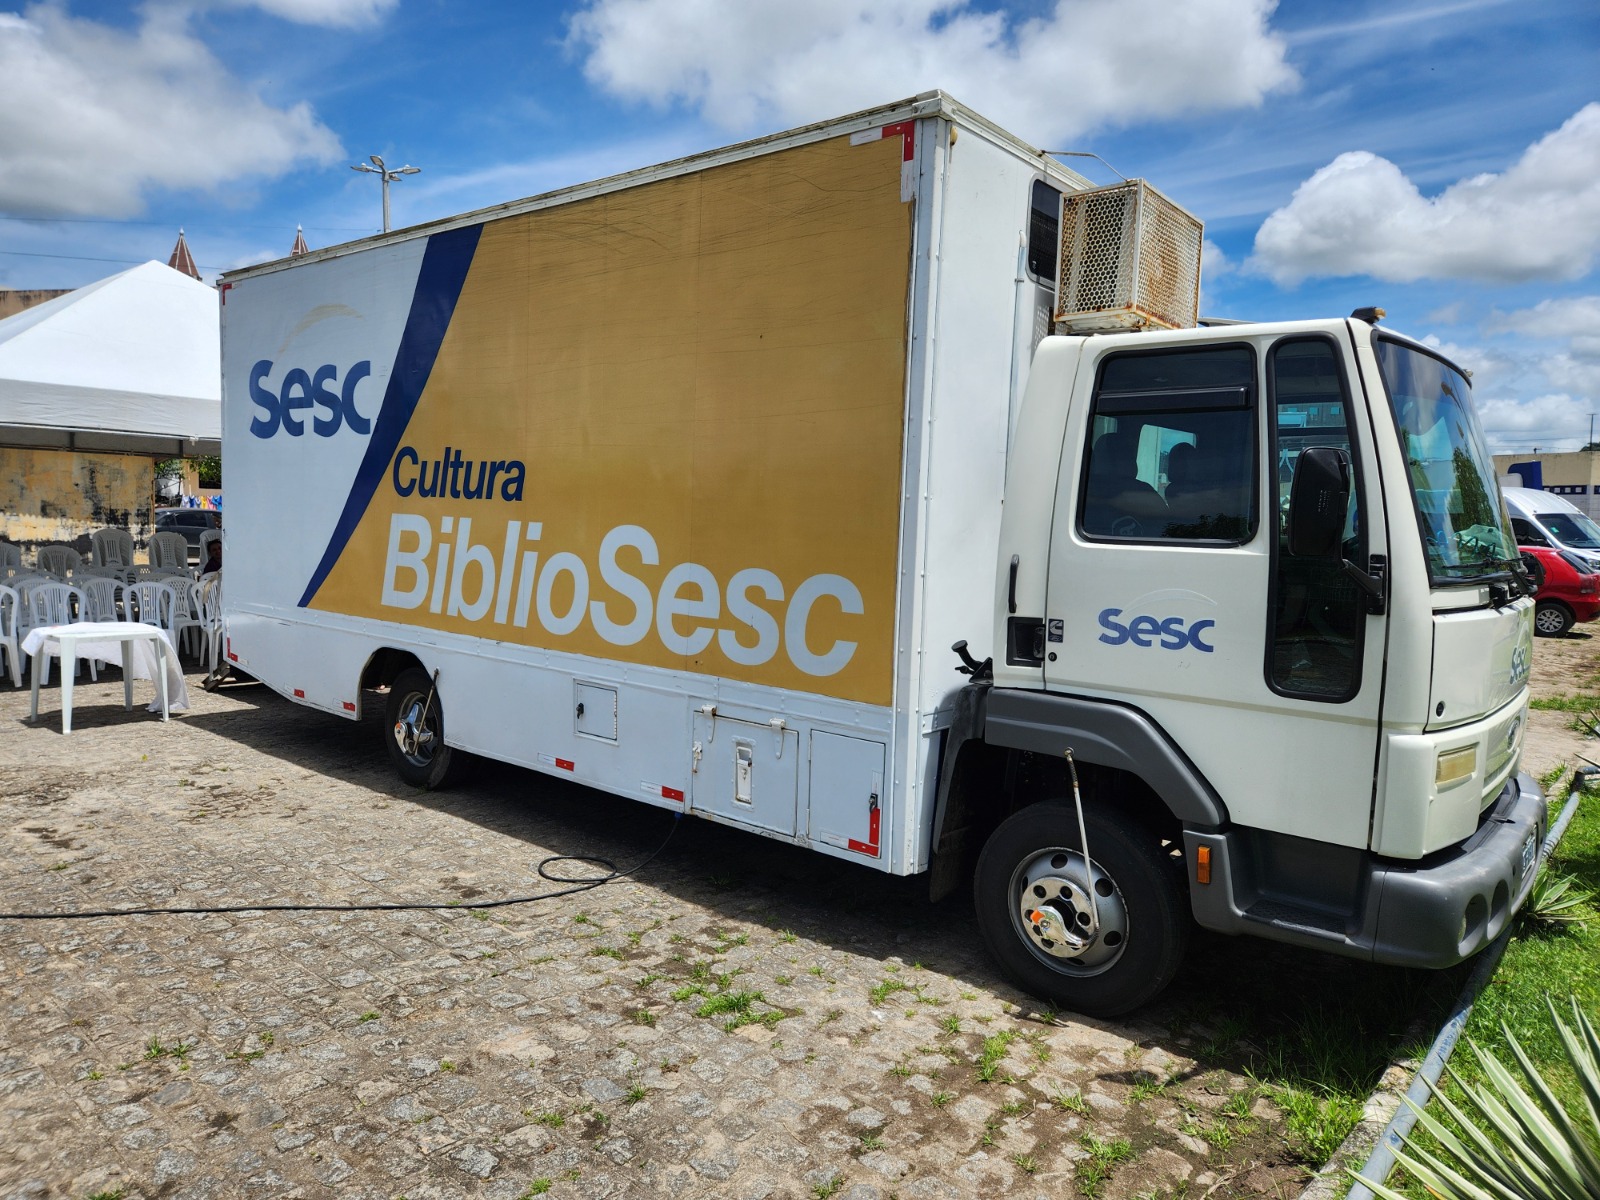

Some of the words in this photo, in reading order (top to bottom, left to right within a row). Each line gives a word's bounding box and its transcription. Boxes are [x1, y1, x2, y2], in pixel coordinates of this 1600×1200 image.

[249, 359, 371, 439] Sesc
[393, 446, 526, 502] Cultura
[380, 512, 864, 677] BiblioSesc
[1098, 607, 1215, 653] Sesc
